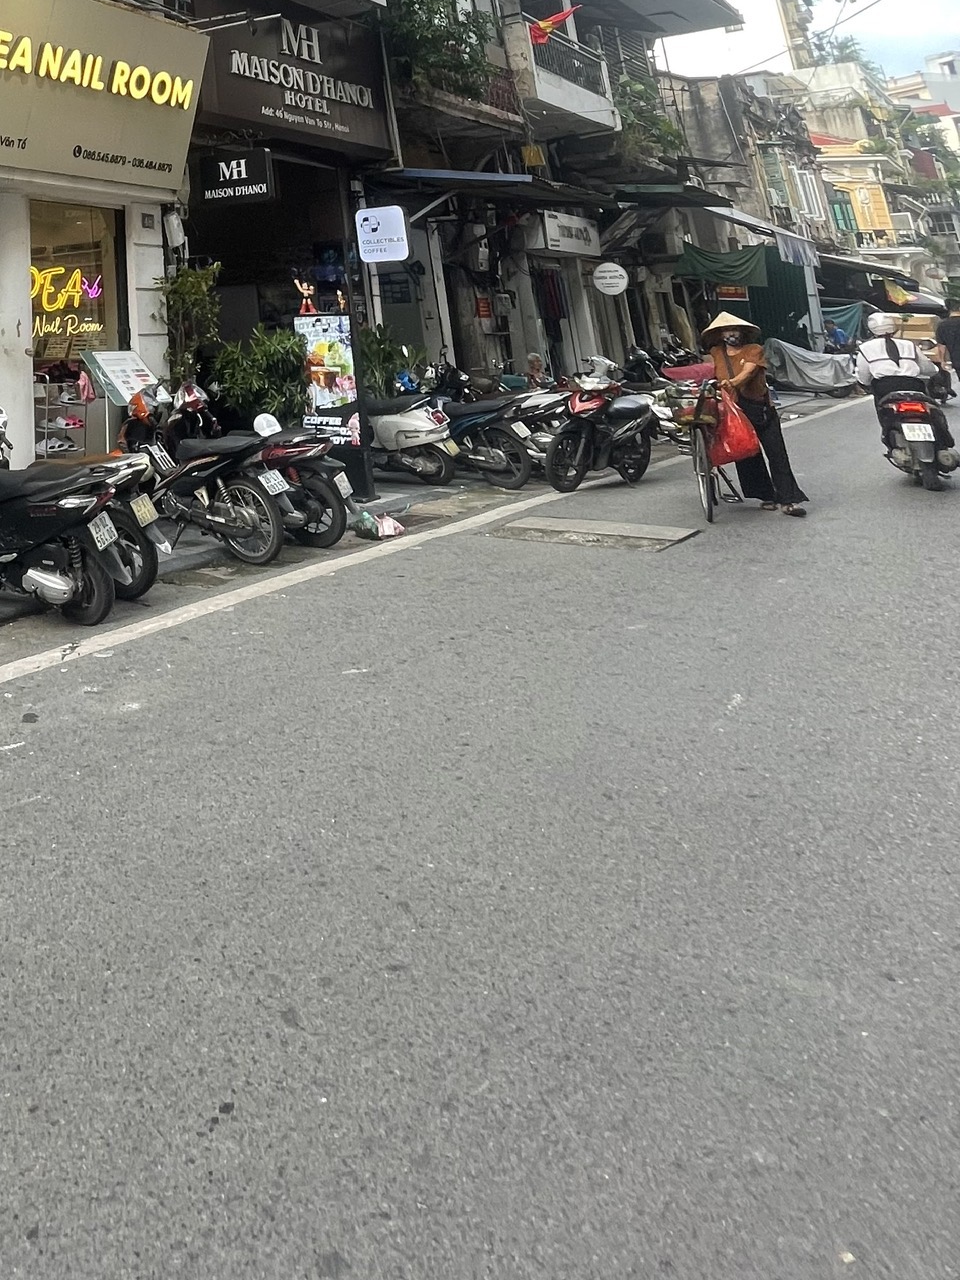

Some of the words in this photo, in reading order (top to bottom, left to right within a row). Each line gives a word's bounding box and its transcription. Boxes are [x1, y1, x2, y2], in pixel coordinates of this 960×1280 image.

[37, 42, 105, 91] NAIL
[111, 60, 194, 110] ROOM
[231, 49, 305, 94] MAISON
[305, 71, 374, 109] D'HANOI
[284, 90, 330, 115] HOTEL
[0, 135, 15, 148] Văn
[218, 158, 248, 182] MH
[204, 187, 234, 200] MAISON
[235, 183, 267, 196] D'HANOI
[32, 315, 63, 337] Nail
